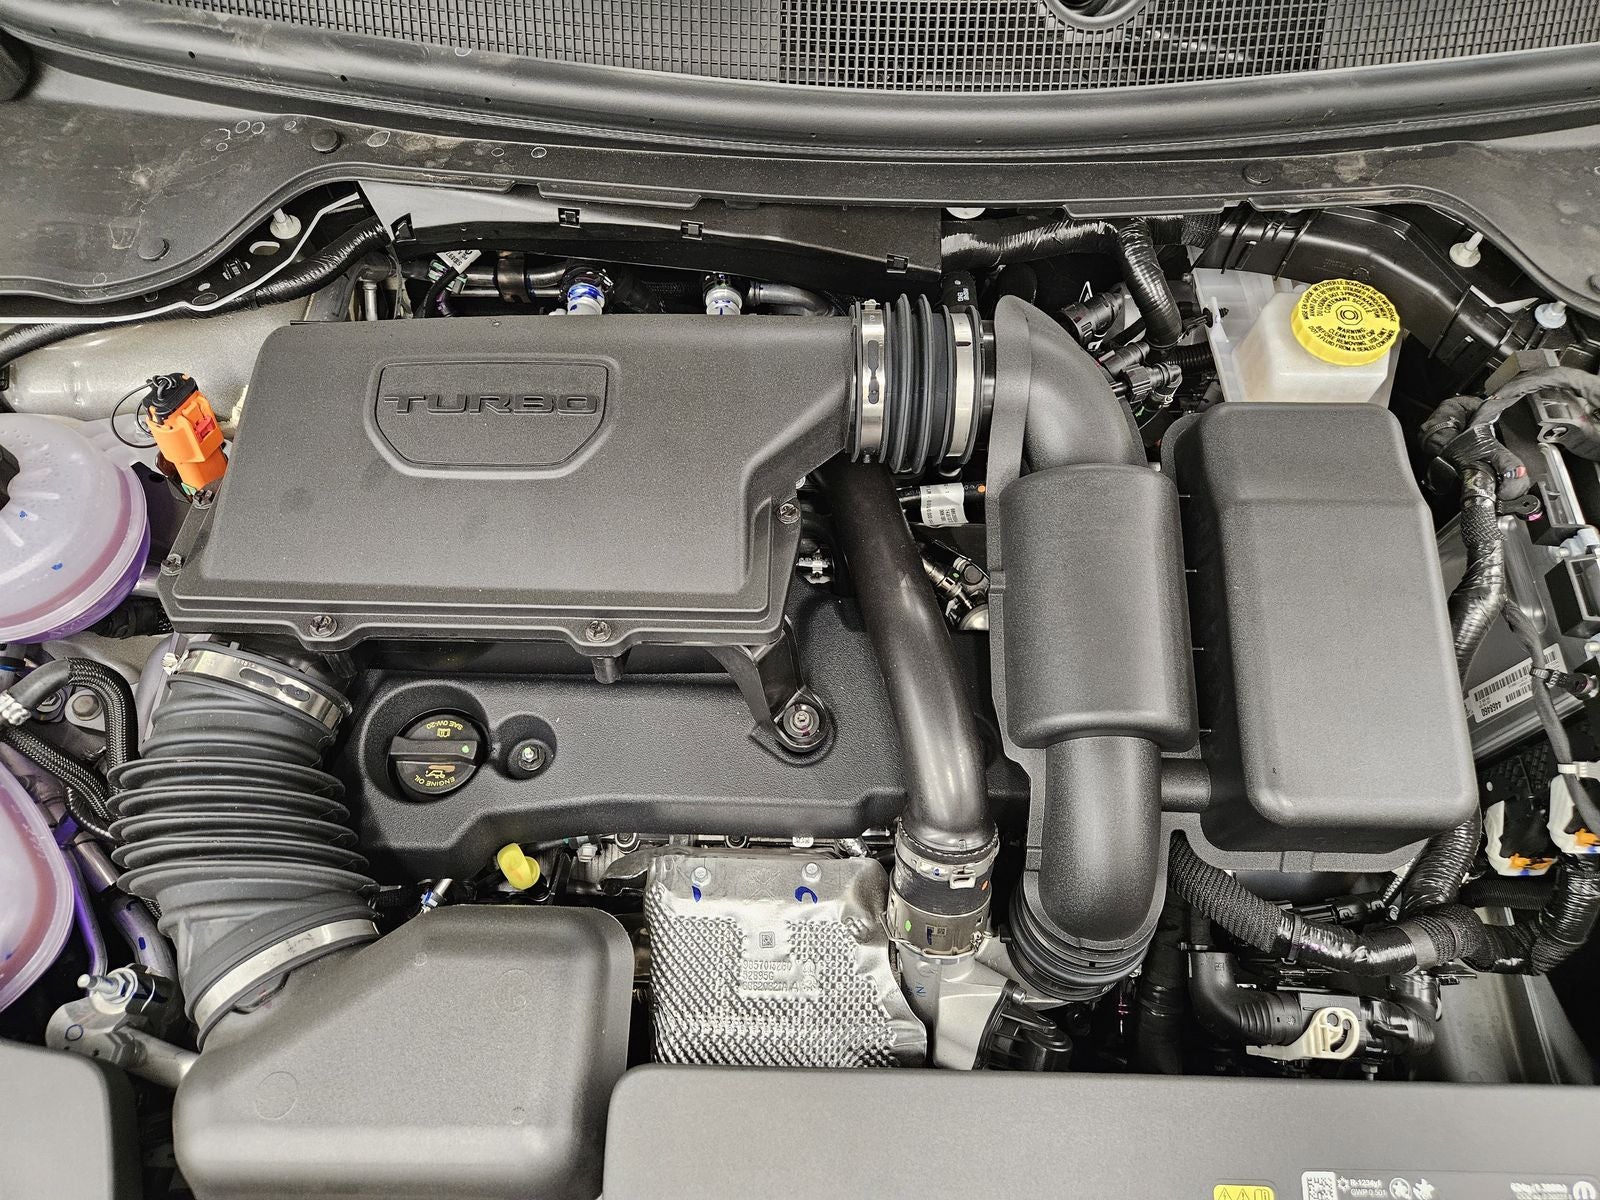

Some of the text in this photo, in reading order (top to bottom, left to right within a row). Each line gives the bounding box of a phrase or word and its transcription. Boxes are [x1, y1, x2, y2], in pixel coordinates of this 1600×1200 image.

[1323, 296, 1350, 314] CONTENANT
[1307, 325, 1319, 335] DOT
[1319, 335, 1335, 347] FLUID
[1334, 343, 1352, 352] FROM
[1315, 325, 1335, 341] BEFORE
[1328, 328, 1347, 340] CLEAN
[1347, 333, 1367, 341] FILLER
[383, 393, 599, 416] TURBO
[426, 719, 464, 731] SAE 0W-20
[414, 774, 456, 788] ENGINE OIL
[1350, 1188, 1368, 1197] GWP
